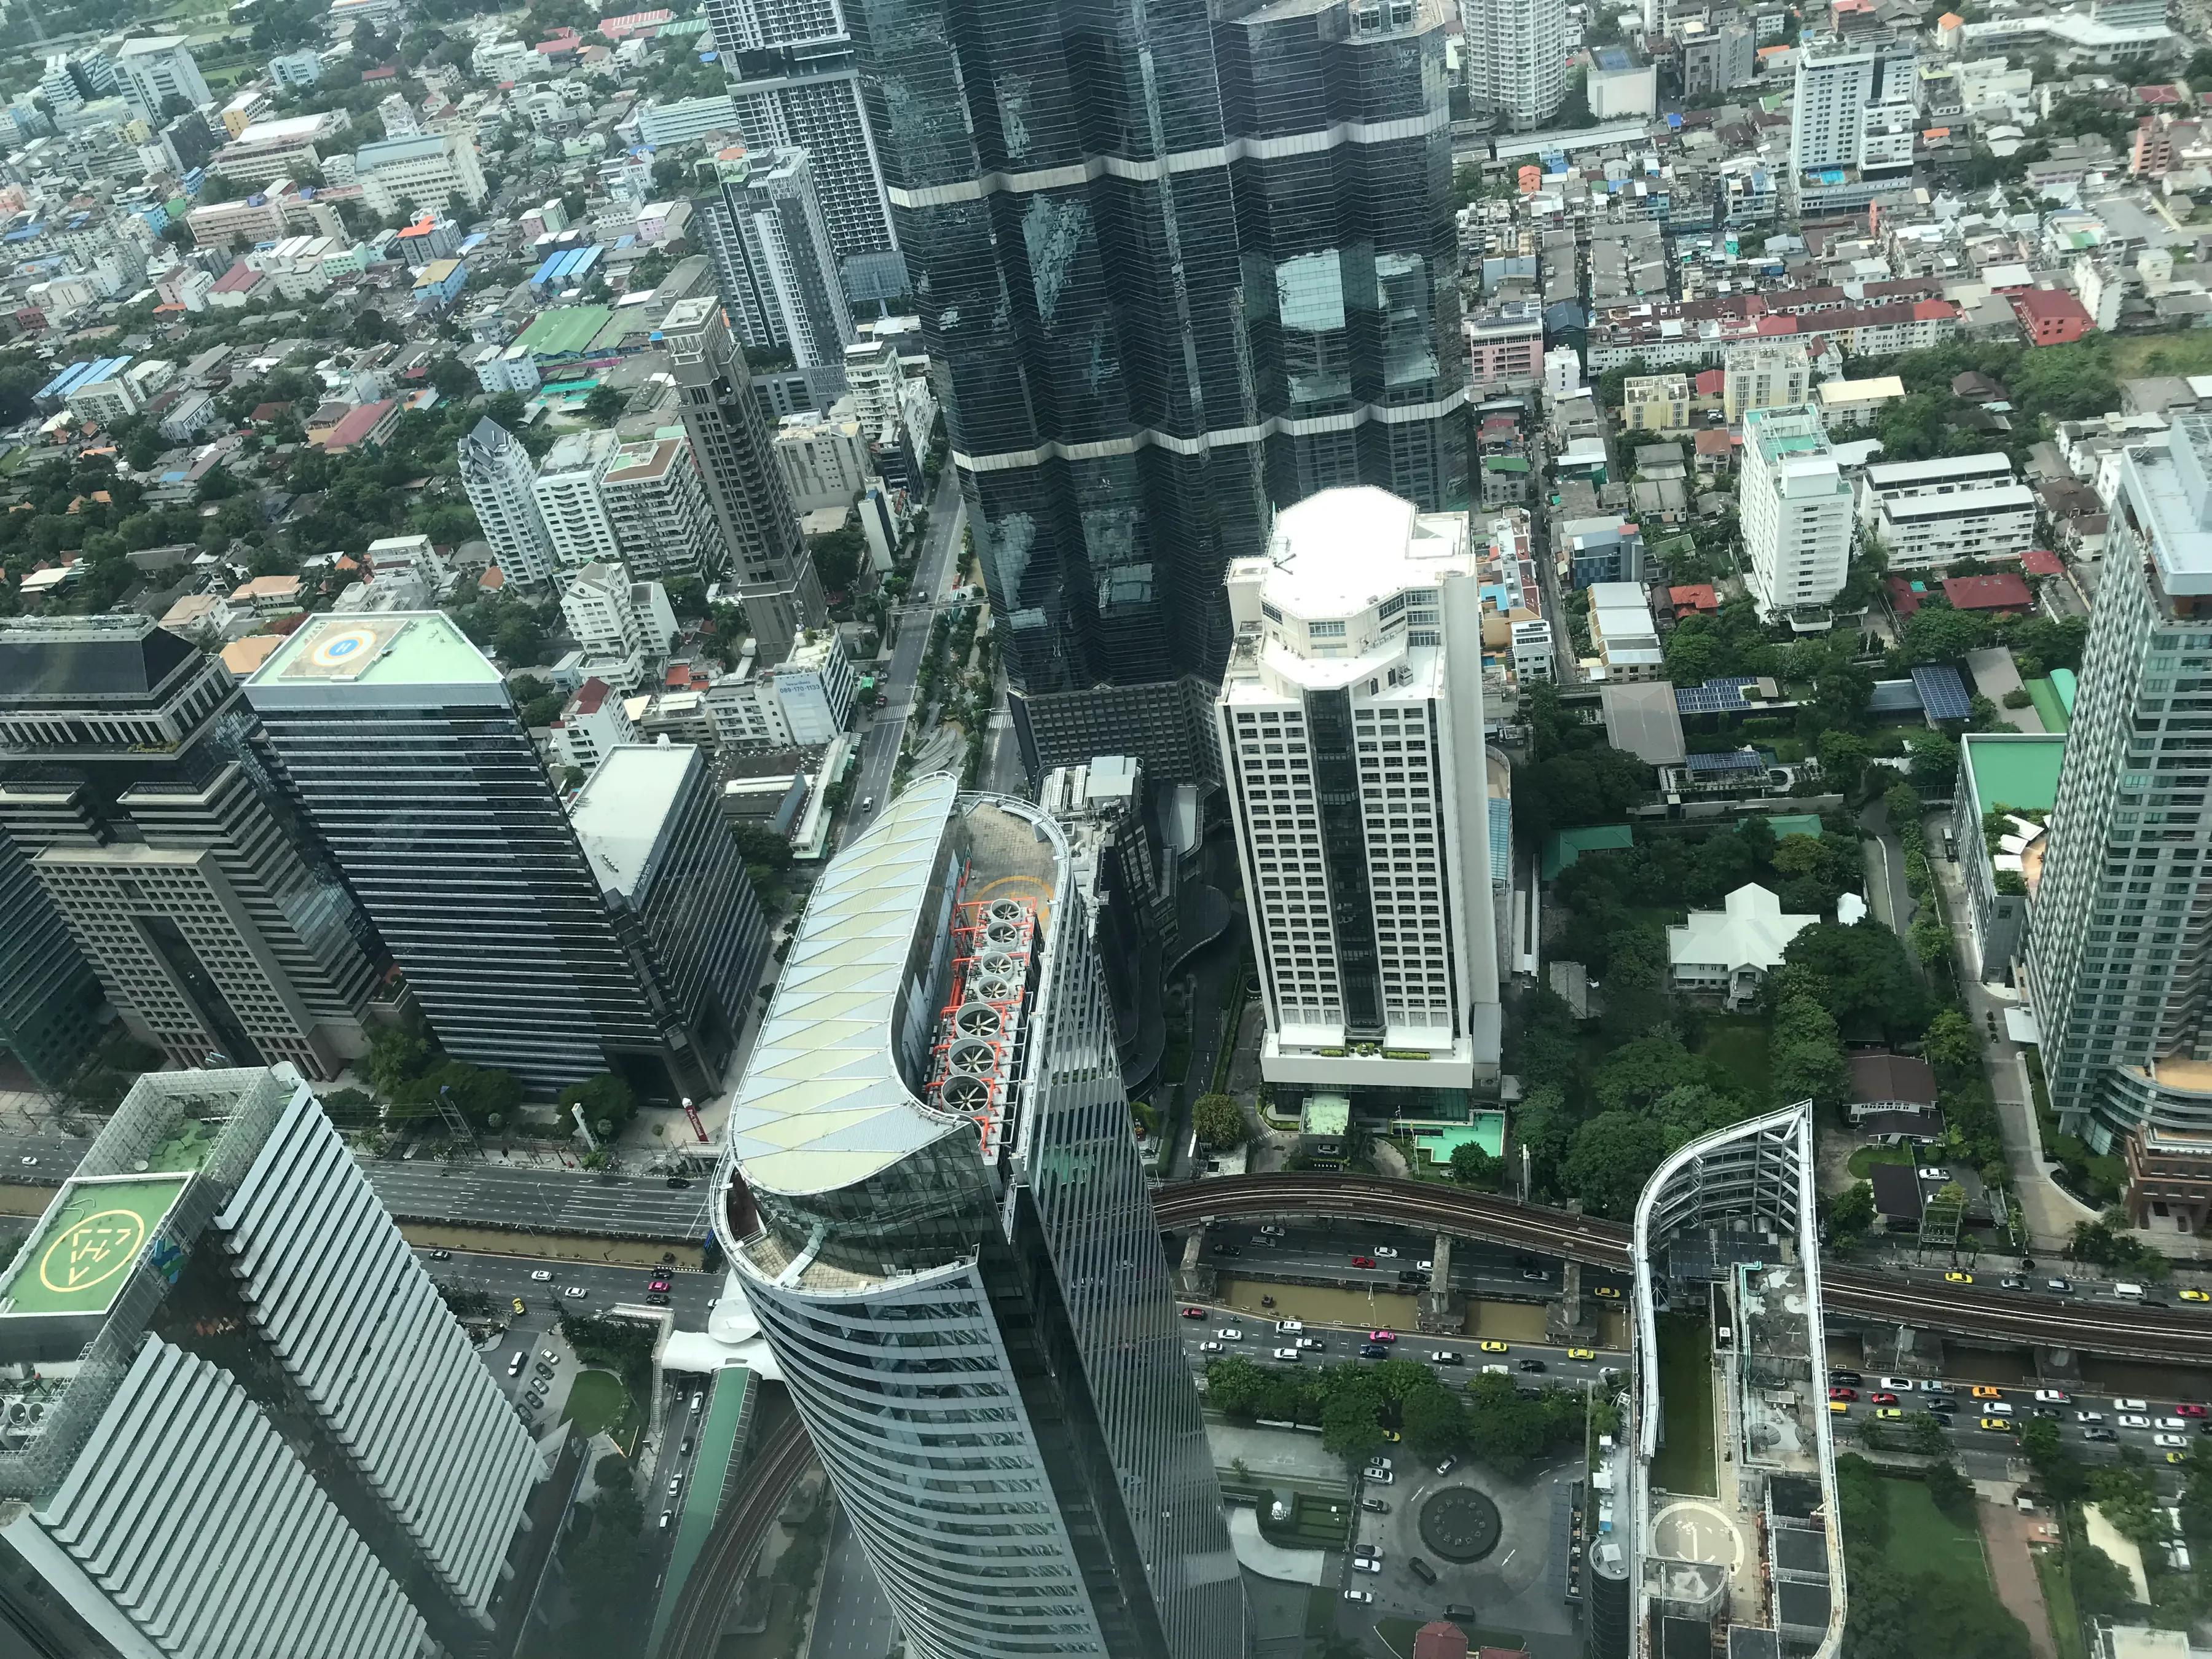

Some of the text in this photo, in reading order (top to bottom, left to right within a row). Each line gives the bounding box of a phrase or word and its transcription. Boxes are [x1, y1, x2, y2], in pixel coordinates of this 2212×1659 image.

[335, 643, 351, 653] H
[780, 684, 820, 694] 089-170-1133
[77, 1239, 108, 1260] H
